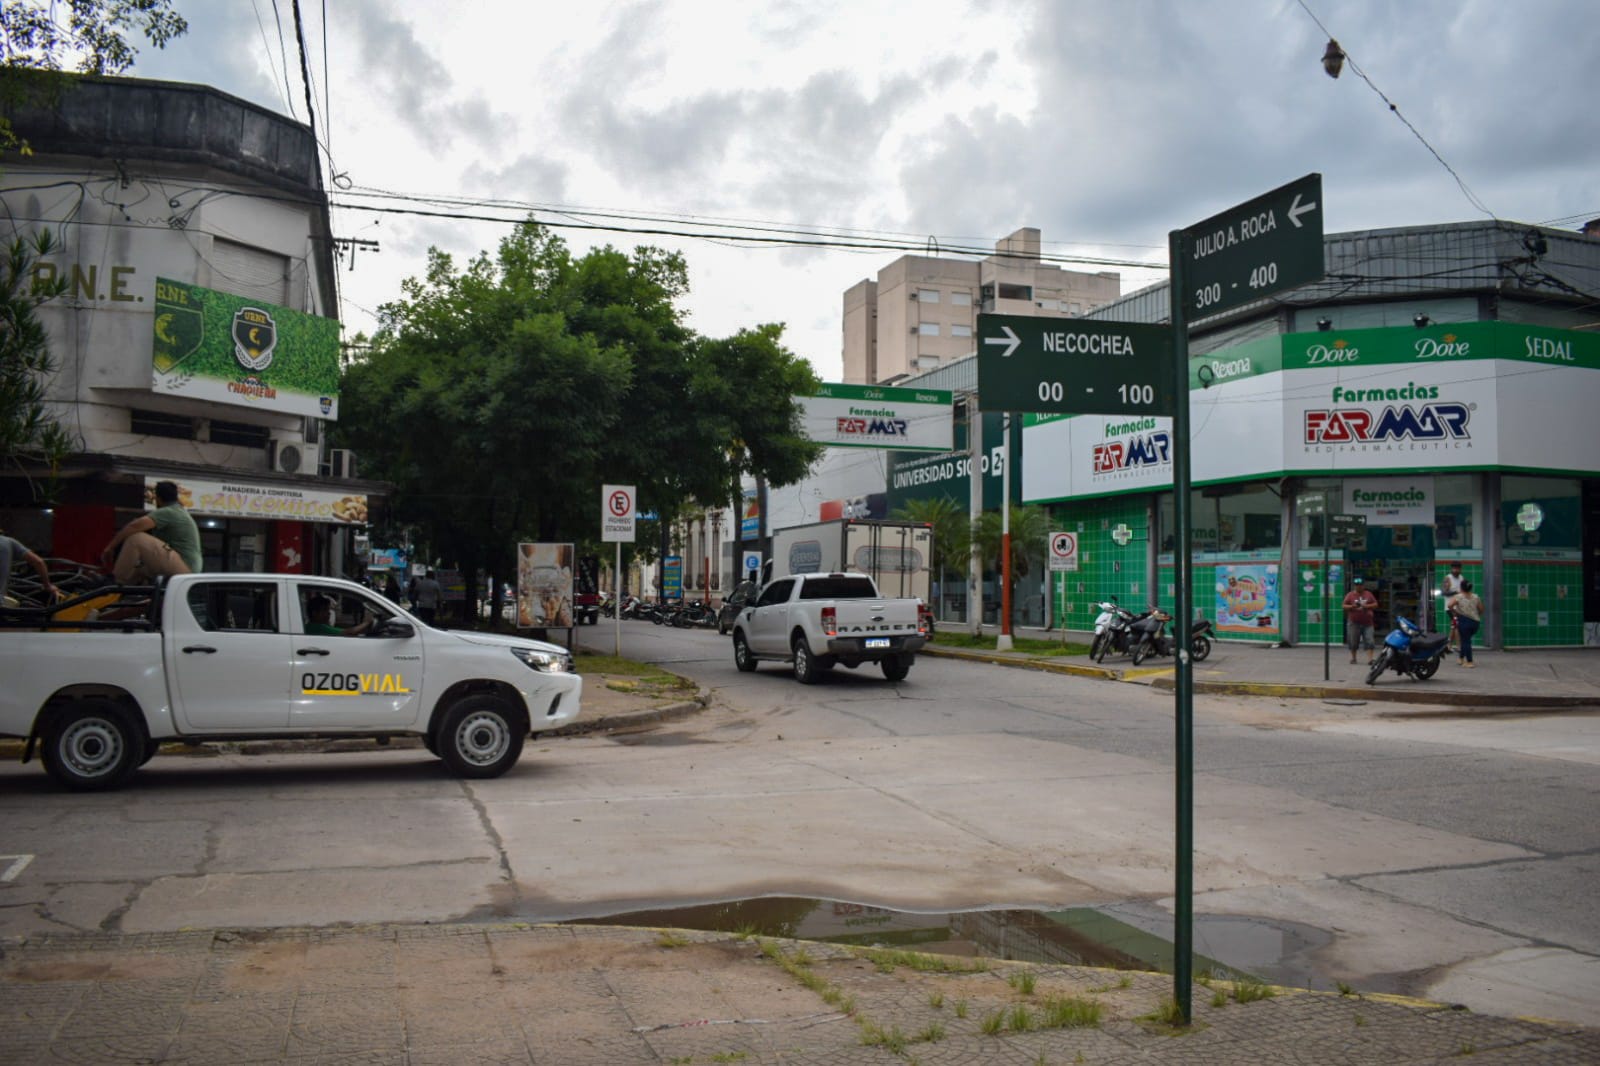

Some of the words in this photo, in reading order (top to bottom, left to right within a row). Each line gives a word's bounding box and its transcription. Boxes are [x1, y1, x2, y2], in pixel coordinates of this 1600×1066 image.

[1194, 230, 1225, 260] JULIO
[1227, 225, 1239, 247] A.
[1241, 209, 1277, 241] ROCA
[1195, 282, 1221, 309] 300
[1249, 262, 1278, 289] 400
[1042, 332, 1134, 355] NECOCHEA
[1306, 344, 1359, 364] Dove
[1415, 338, 1470, 358] Dove
[1525, 335, 1575, 361] SEDAL
[1212, 358, 1250, 379] Rexona
[1038, 381, 1064, 402] 00
[1118, 383, 1154, 404] 100
[1332, 382, 1439, 403] Farmacias
[849, 407, 895, 417] Farmacias
[837, 417, 908, 436] FARMAR
[1105, 416, 1156, 437] Farmacias
[1304, 402, 1472, 445] FARMAR
[1093, 431, 1172, 475] FARMAR
[893, 462, 954, 489] UNIVERSIDAD
[956, 455, 989, 478] SIO
[1352, 486, 1425, 502] Farmacia
[838, 624, 916, 632] RANGER
